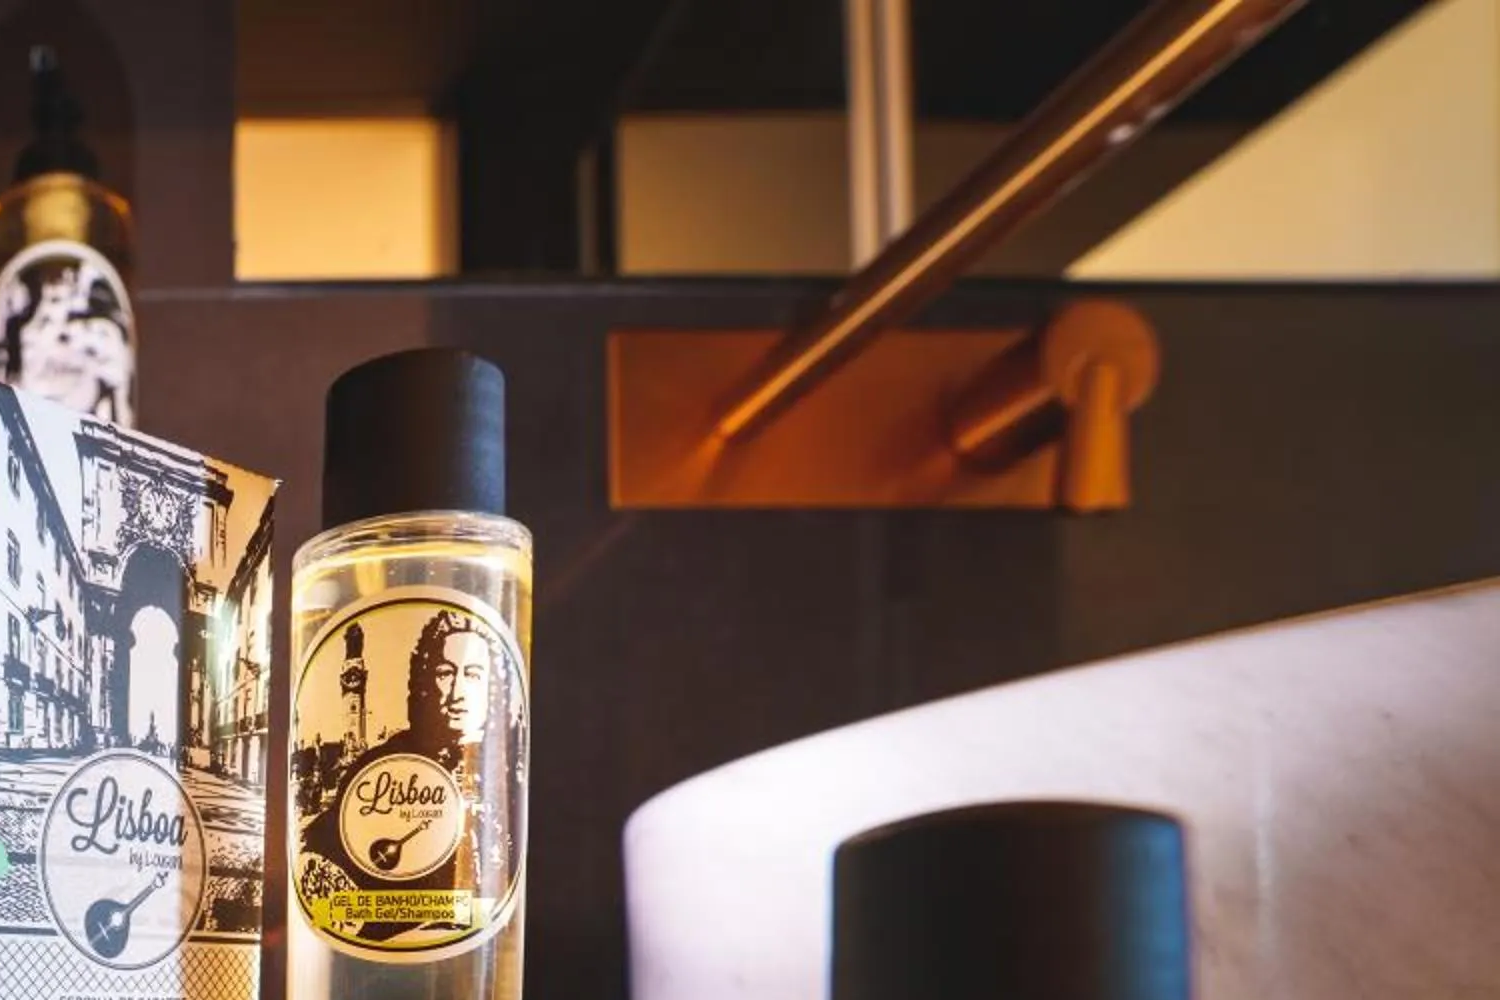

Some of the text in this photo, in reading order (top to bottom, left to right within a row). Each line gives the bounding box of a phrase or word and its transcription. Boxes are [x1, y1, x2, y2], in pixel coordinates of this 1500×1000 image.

[356, 771, 447, 816] Lisboa
[65, 776, 189, 855] Lisboa
[334, 895, 352, 908] GEL
[357, 895, 372, 907] DE
[345, 908, 372, 920] Bath
